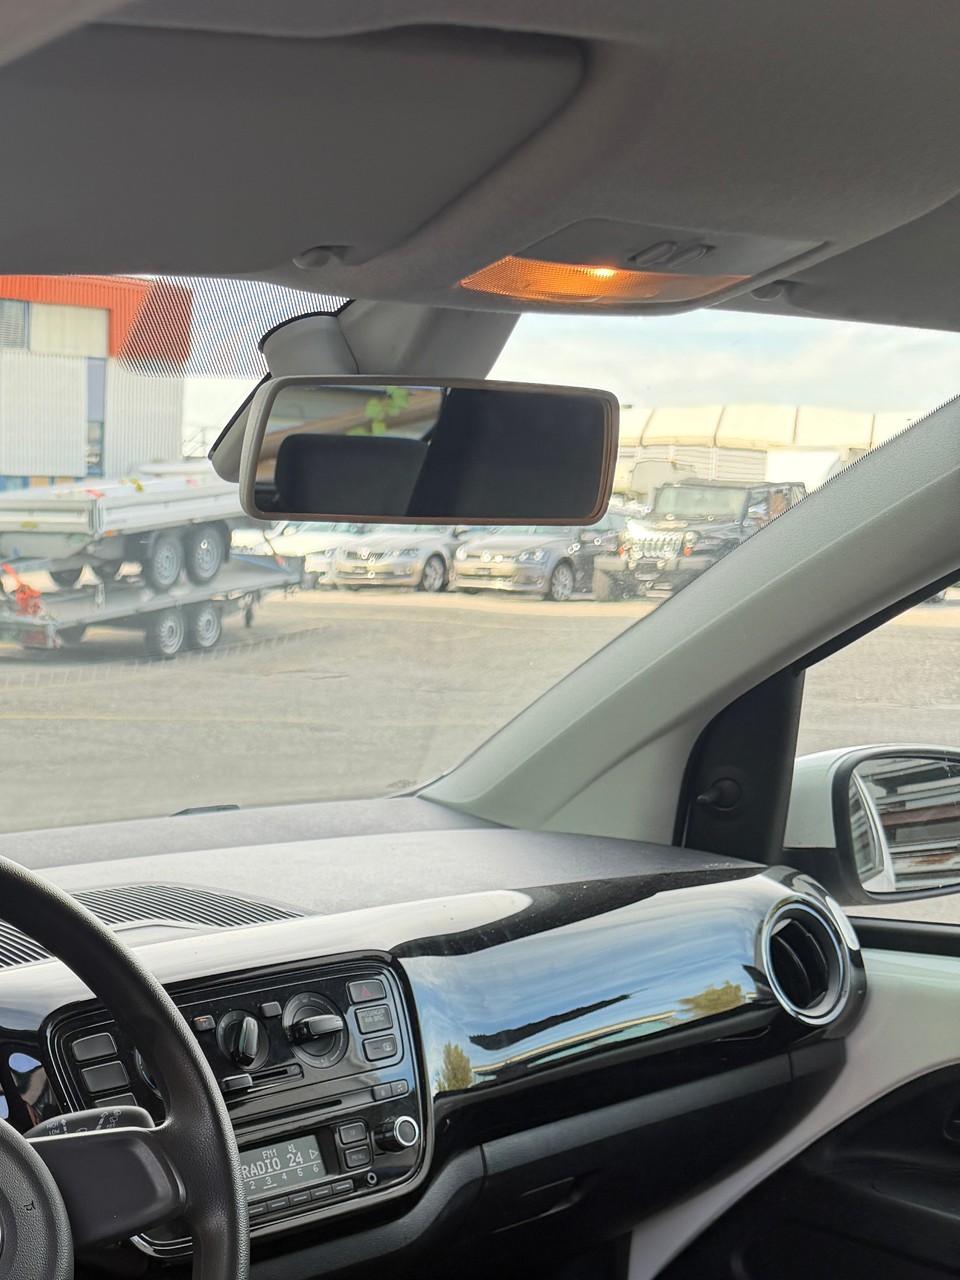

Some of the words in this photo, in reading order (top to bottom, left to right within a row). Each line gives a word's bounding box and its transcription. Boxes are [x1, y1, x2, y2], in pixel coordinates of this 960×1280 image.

[241, 1158, 281, 1179] RADIO
[286, 1152, 304, 1167] 24
[261, 1148, 278, 1160] FM1
[249, 1181, 256, 1190] 2
[265, 1177, 272, 1185] 3
[281, 1172, 288, 1181] 4
[297, 1168, 304, 1177] 5
[313, 1164, 319, 1173] 6
